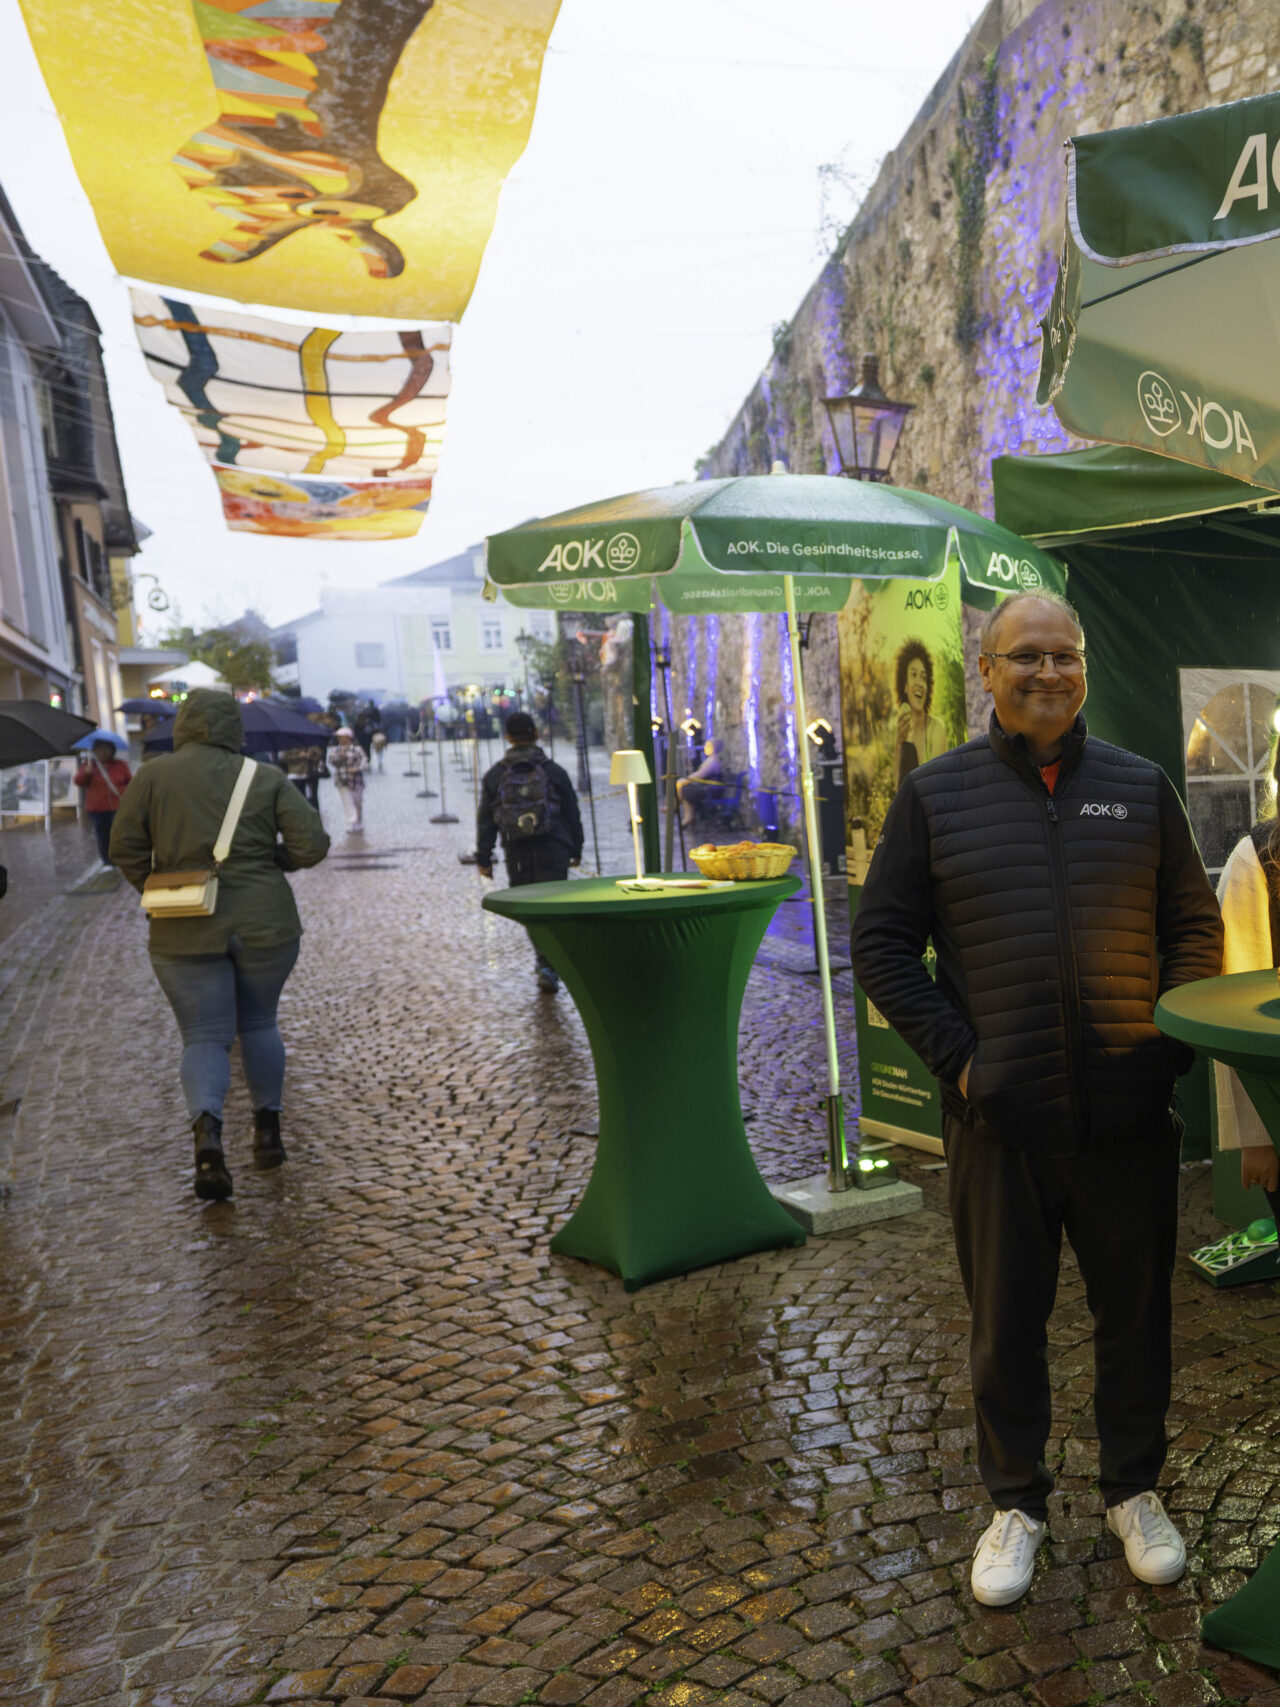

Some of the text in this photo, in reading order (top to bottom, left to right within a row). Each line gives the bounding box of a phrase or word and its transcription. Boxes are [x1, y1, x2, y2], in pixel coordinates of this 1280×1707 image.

[537, 539, 606, 572] AOK
[727, 540, 923, 561] AOK. Die Gesundheitskasse.
[904, 589, 934, 611] AOK
[1080, 803, 1112, 816] AOK
